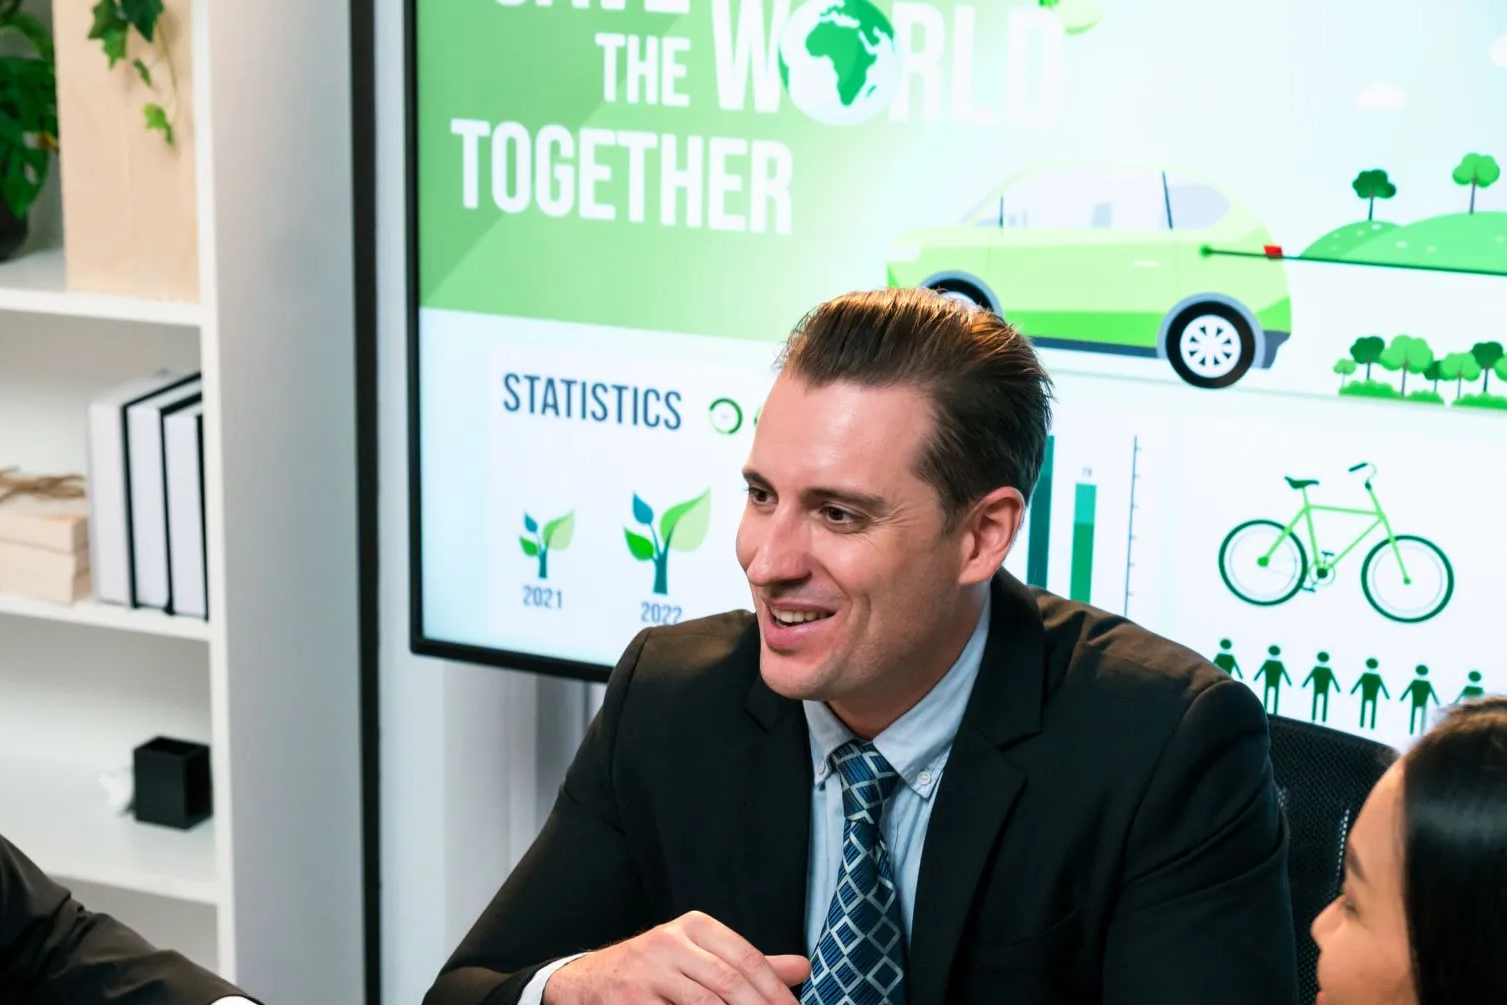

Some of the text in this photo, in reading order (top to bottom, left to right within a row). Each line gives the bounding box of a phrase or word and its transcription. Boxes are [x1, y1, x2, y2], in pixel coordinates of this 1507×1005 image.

[595, 32, 691, 107] THE
[450, 118, 794, 235] TOGETHER
[502, 372, 682, 430] STATISTICS
[522, 585, 563, 609] 2021
[640, 601, 683, 625] 2022
